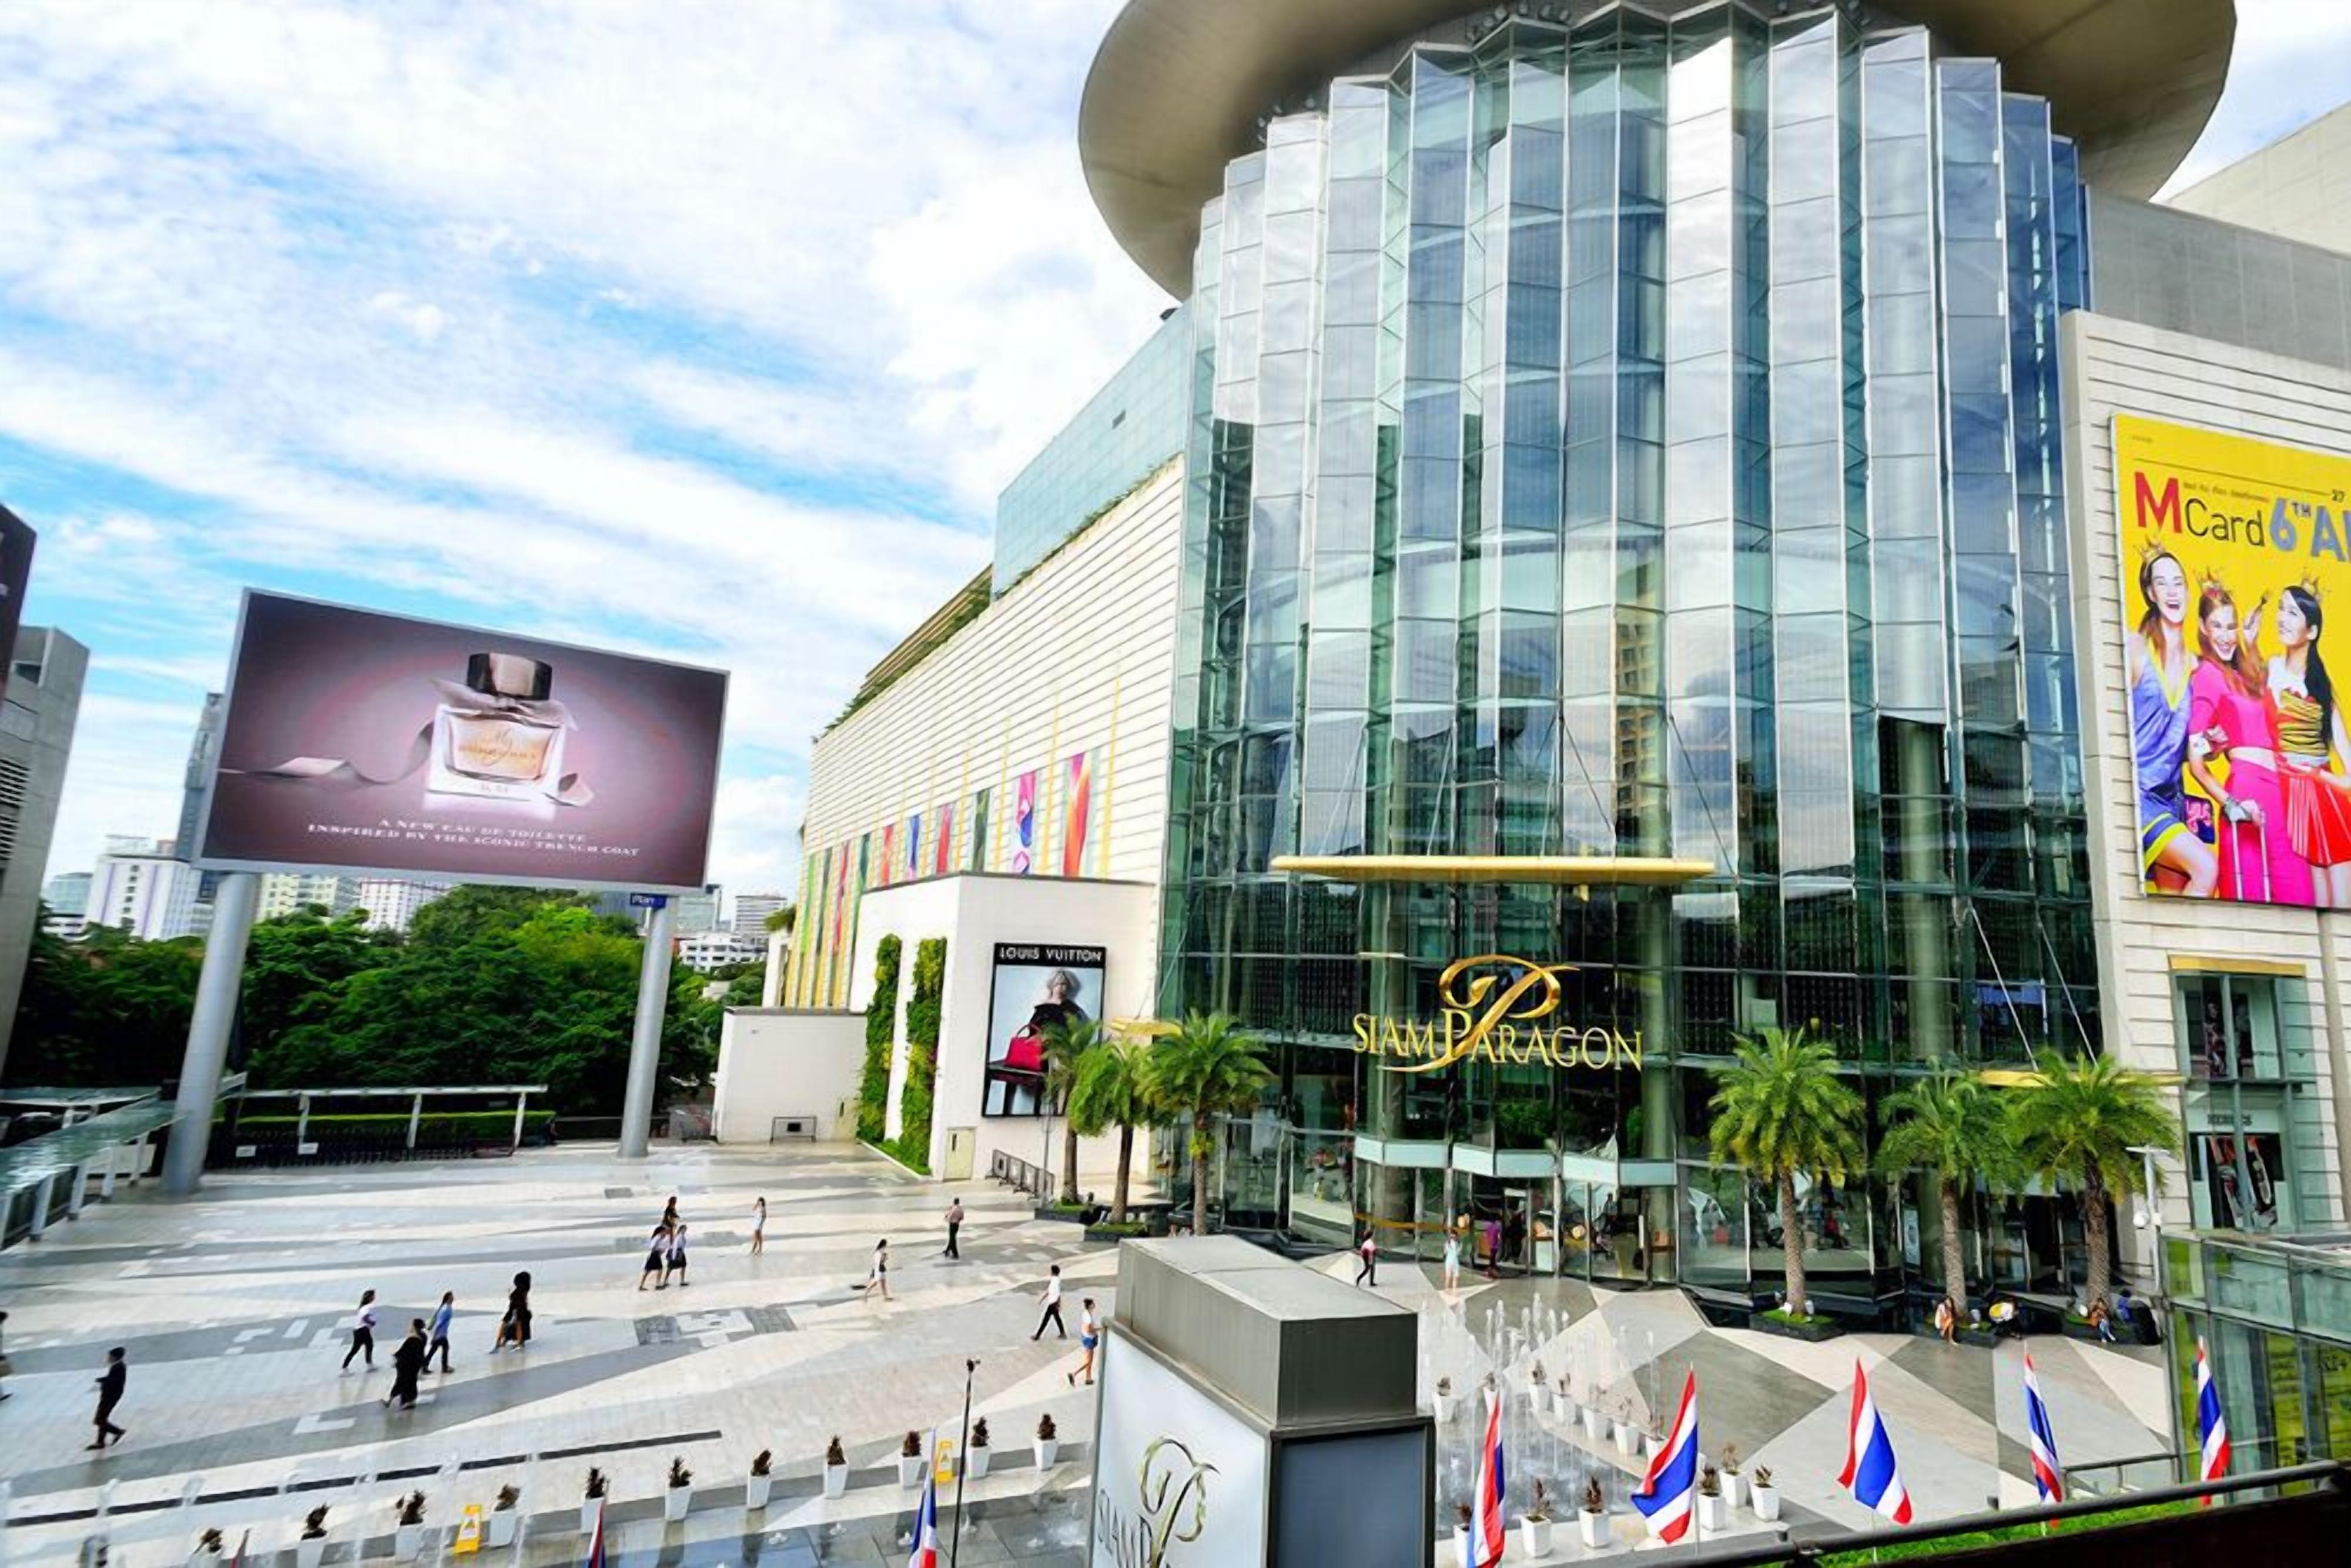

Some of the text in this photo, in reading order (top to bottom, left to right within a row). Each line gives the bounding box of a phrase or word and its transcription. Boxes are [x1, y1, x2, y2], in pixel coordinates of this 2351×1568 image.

[308, 824, 400, 837] INSPIRED
[1000, 947, 1102, 962] LOUIS VUITTON
[1353, 1008, 1643, 1073] SIAM PARAGON
